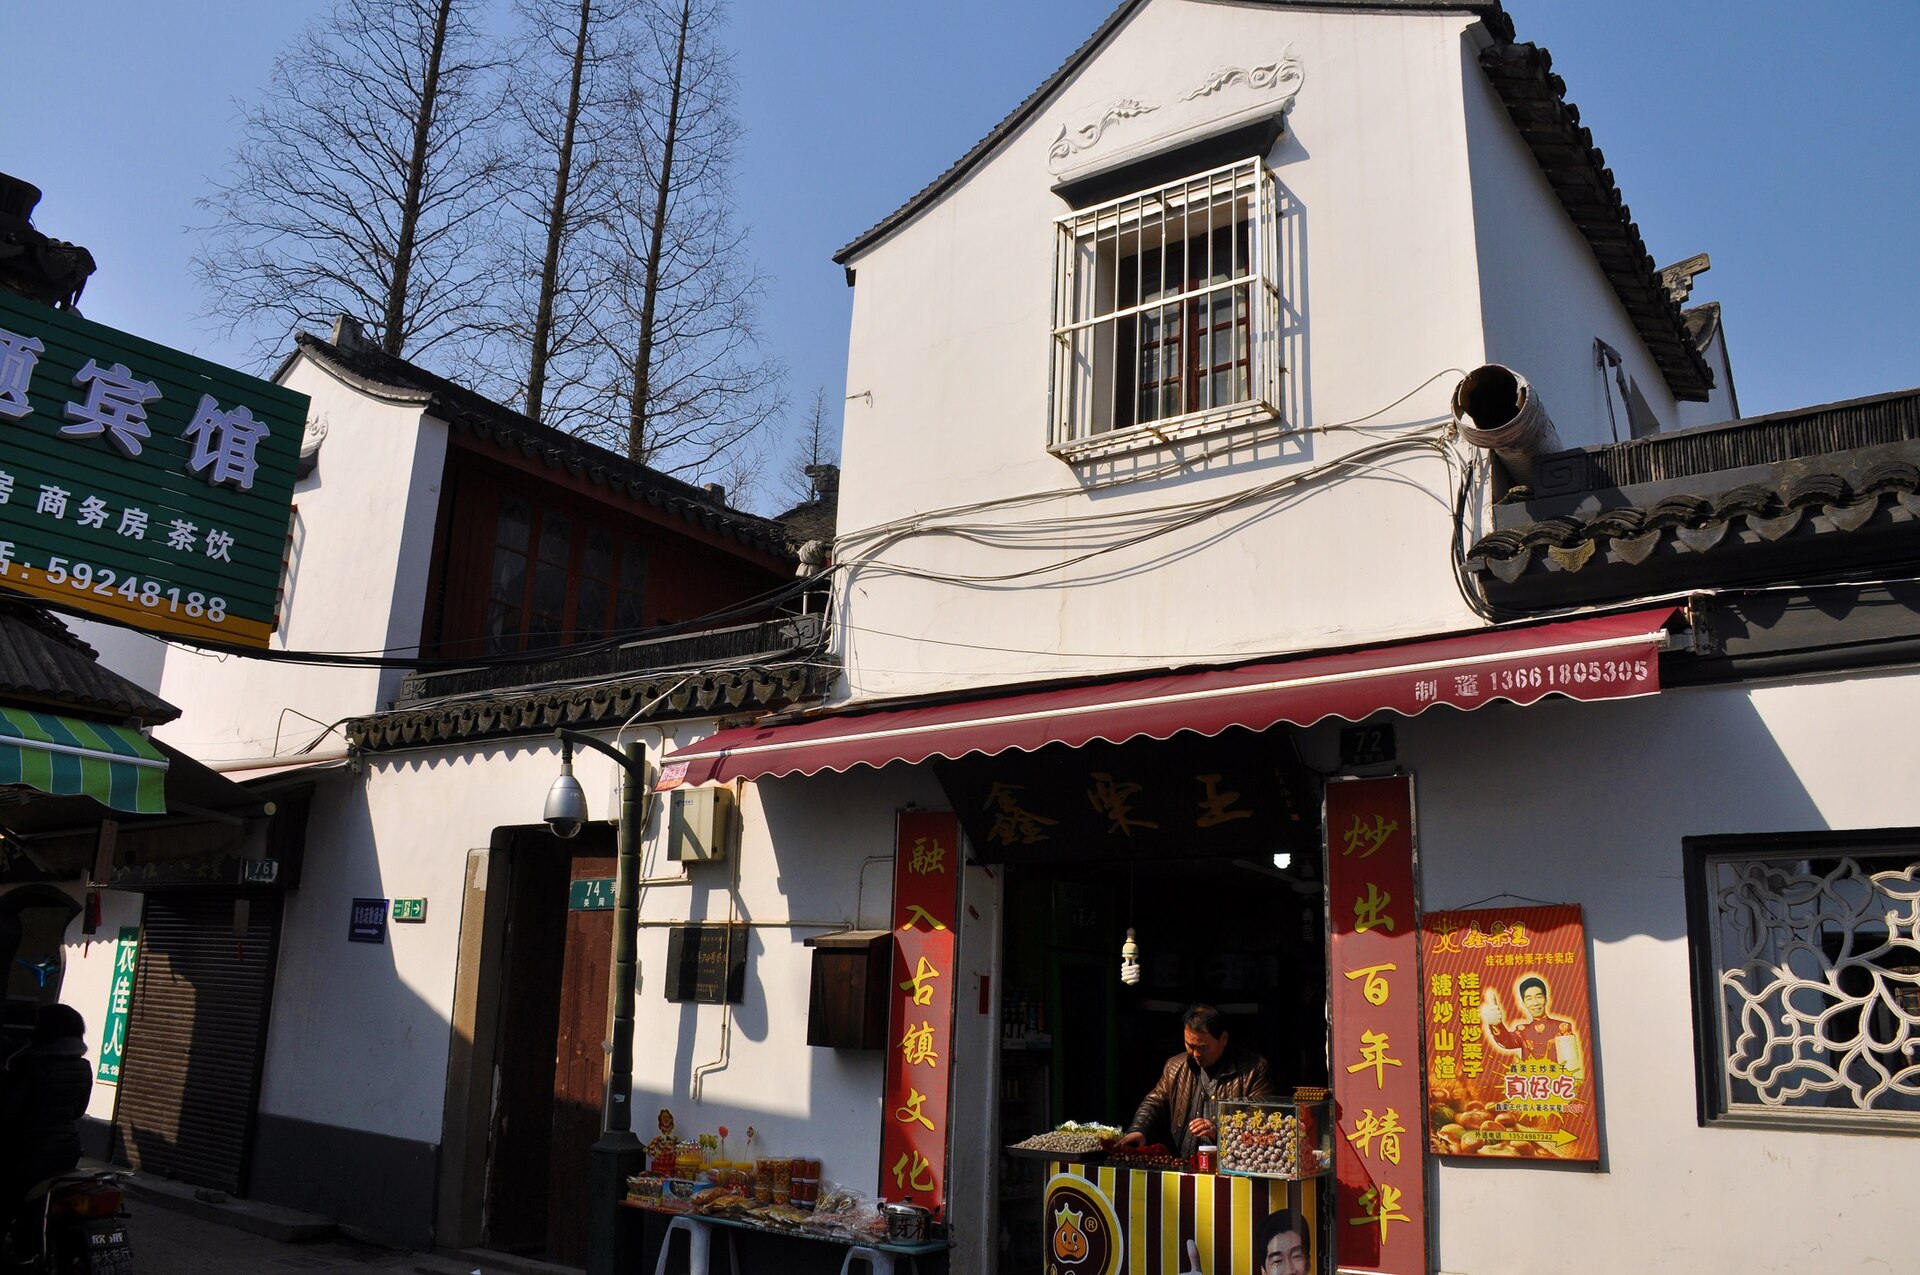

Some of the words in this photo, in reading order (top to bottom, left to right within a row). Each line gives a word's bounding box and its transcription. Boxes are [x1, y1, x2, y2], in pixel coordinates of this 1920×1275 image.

[36, 483, 149, 541] 商务房
[166, 518, 235, 563] 茶饮
[46, 555, 227, 623] 59248188
[1490, 660, 1649, 691] 13661805305
[1355, 730, 1383, 753] 72
[255, 861, 270, 875] 76
[586, 881, 600, 897] 74
[1485, 952, 1575, 967] 桂花糖炒栗子专卖店
[892, 838, 946, 1192] 融入古镇文化
[1342, 813, 1411, 1246] 炒出百年精华
[1431, 973, 1456, 1080] 糖炒山楂
[1457, 972, 1484, 1079] 桂花糖炒栗子
[1505, 1075, 1575, 1100] 真好吃
